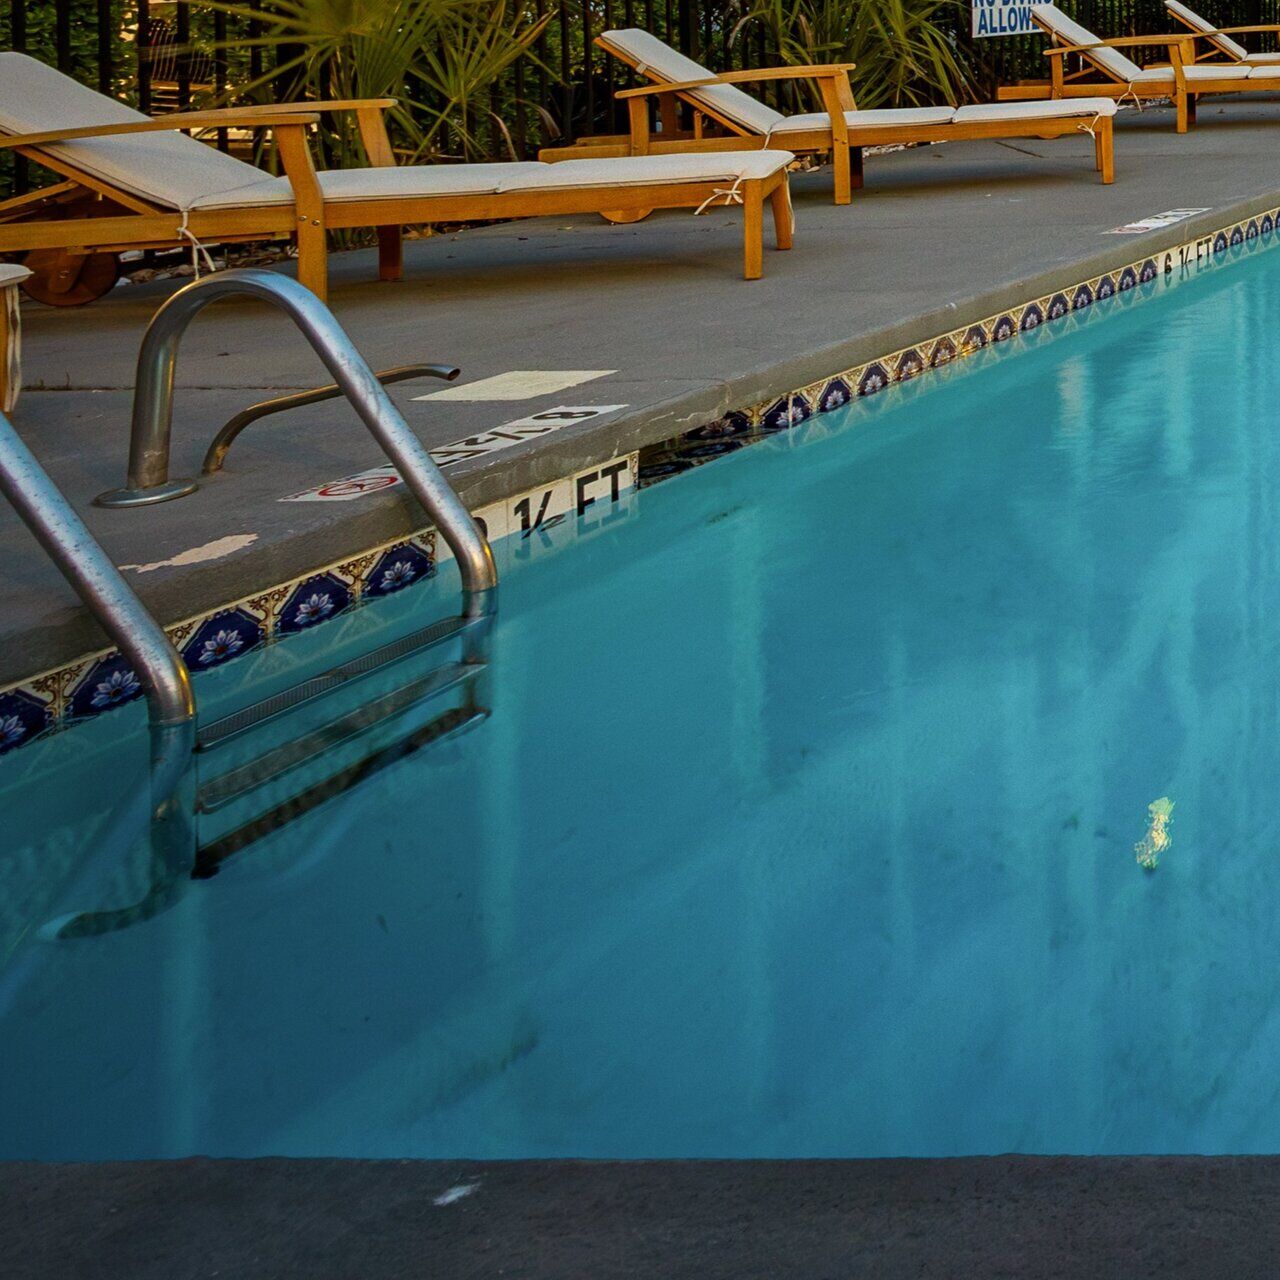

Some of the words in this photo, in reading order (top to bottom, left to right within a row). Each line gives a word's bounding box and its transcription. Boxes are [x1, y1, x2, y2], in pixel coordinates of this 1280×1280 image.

[978, 7, 1040, 35] ALLOW
[1196, 237, 1212, 261] FT
[576, 459, 628, 518] FT
